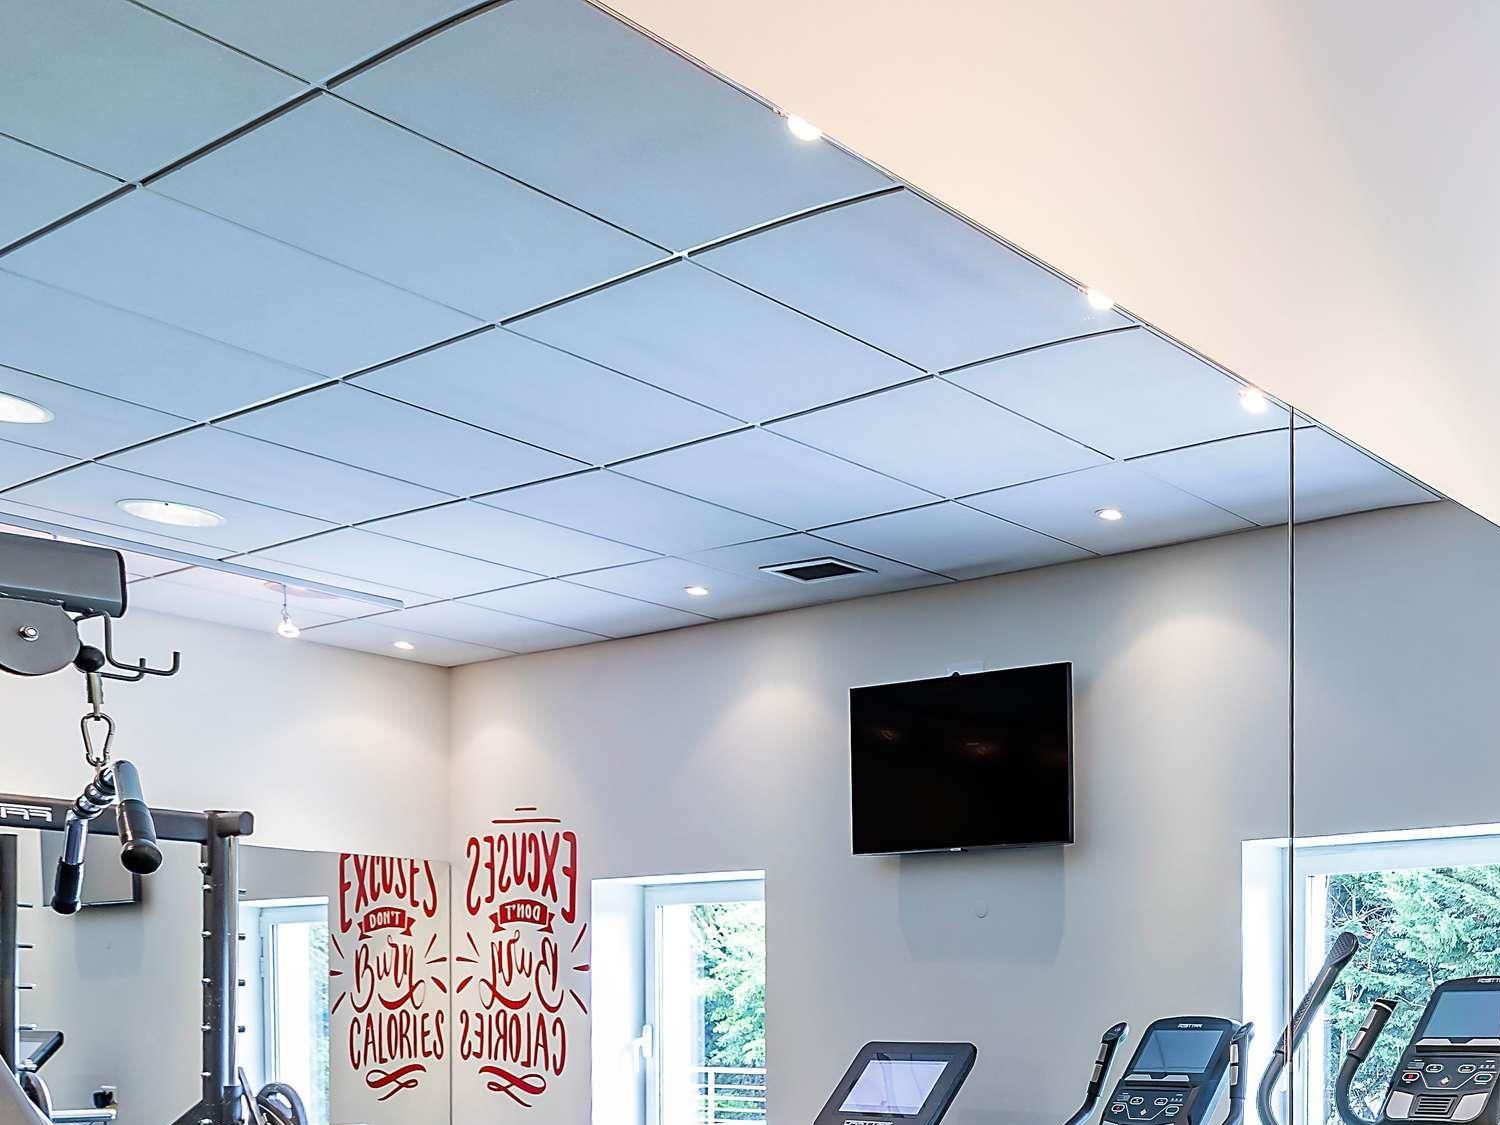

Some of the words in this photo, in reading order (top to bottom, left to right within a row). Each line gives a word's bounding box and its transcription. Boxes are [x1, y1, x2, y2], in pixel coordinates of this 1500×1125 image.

[369, 911, 400, 928] DON'T
[350, 935, 426, 1014] Burn
[350, 1009, 444, 1070] CALORIES
